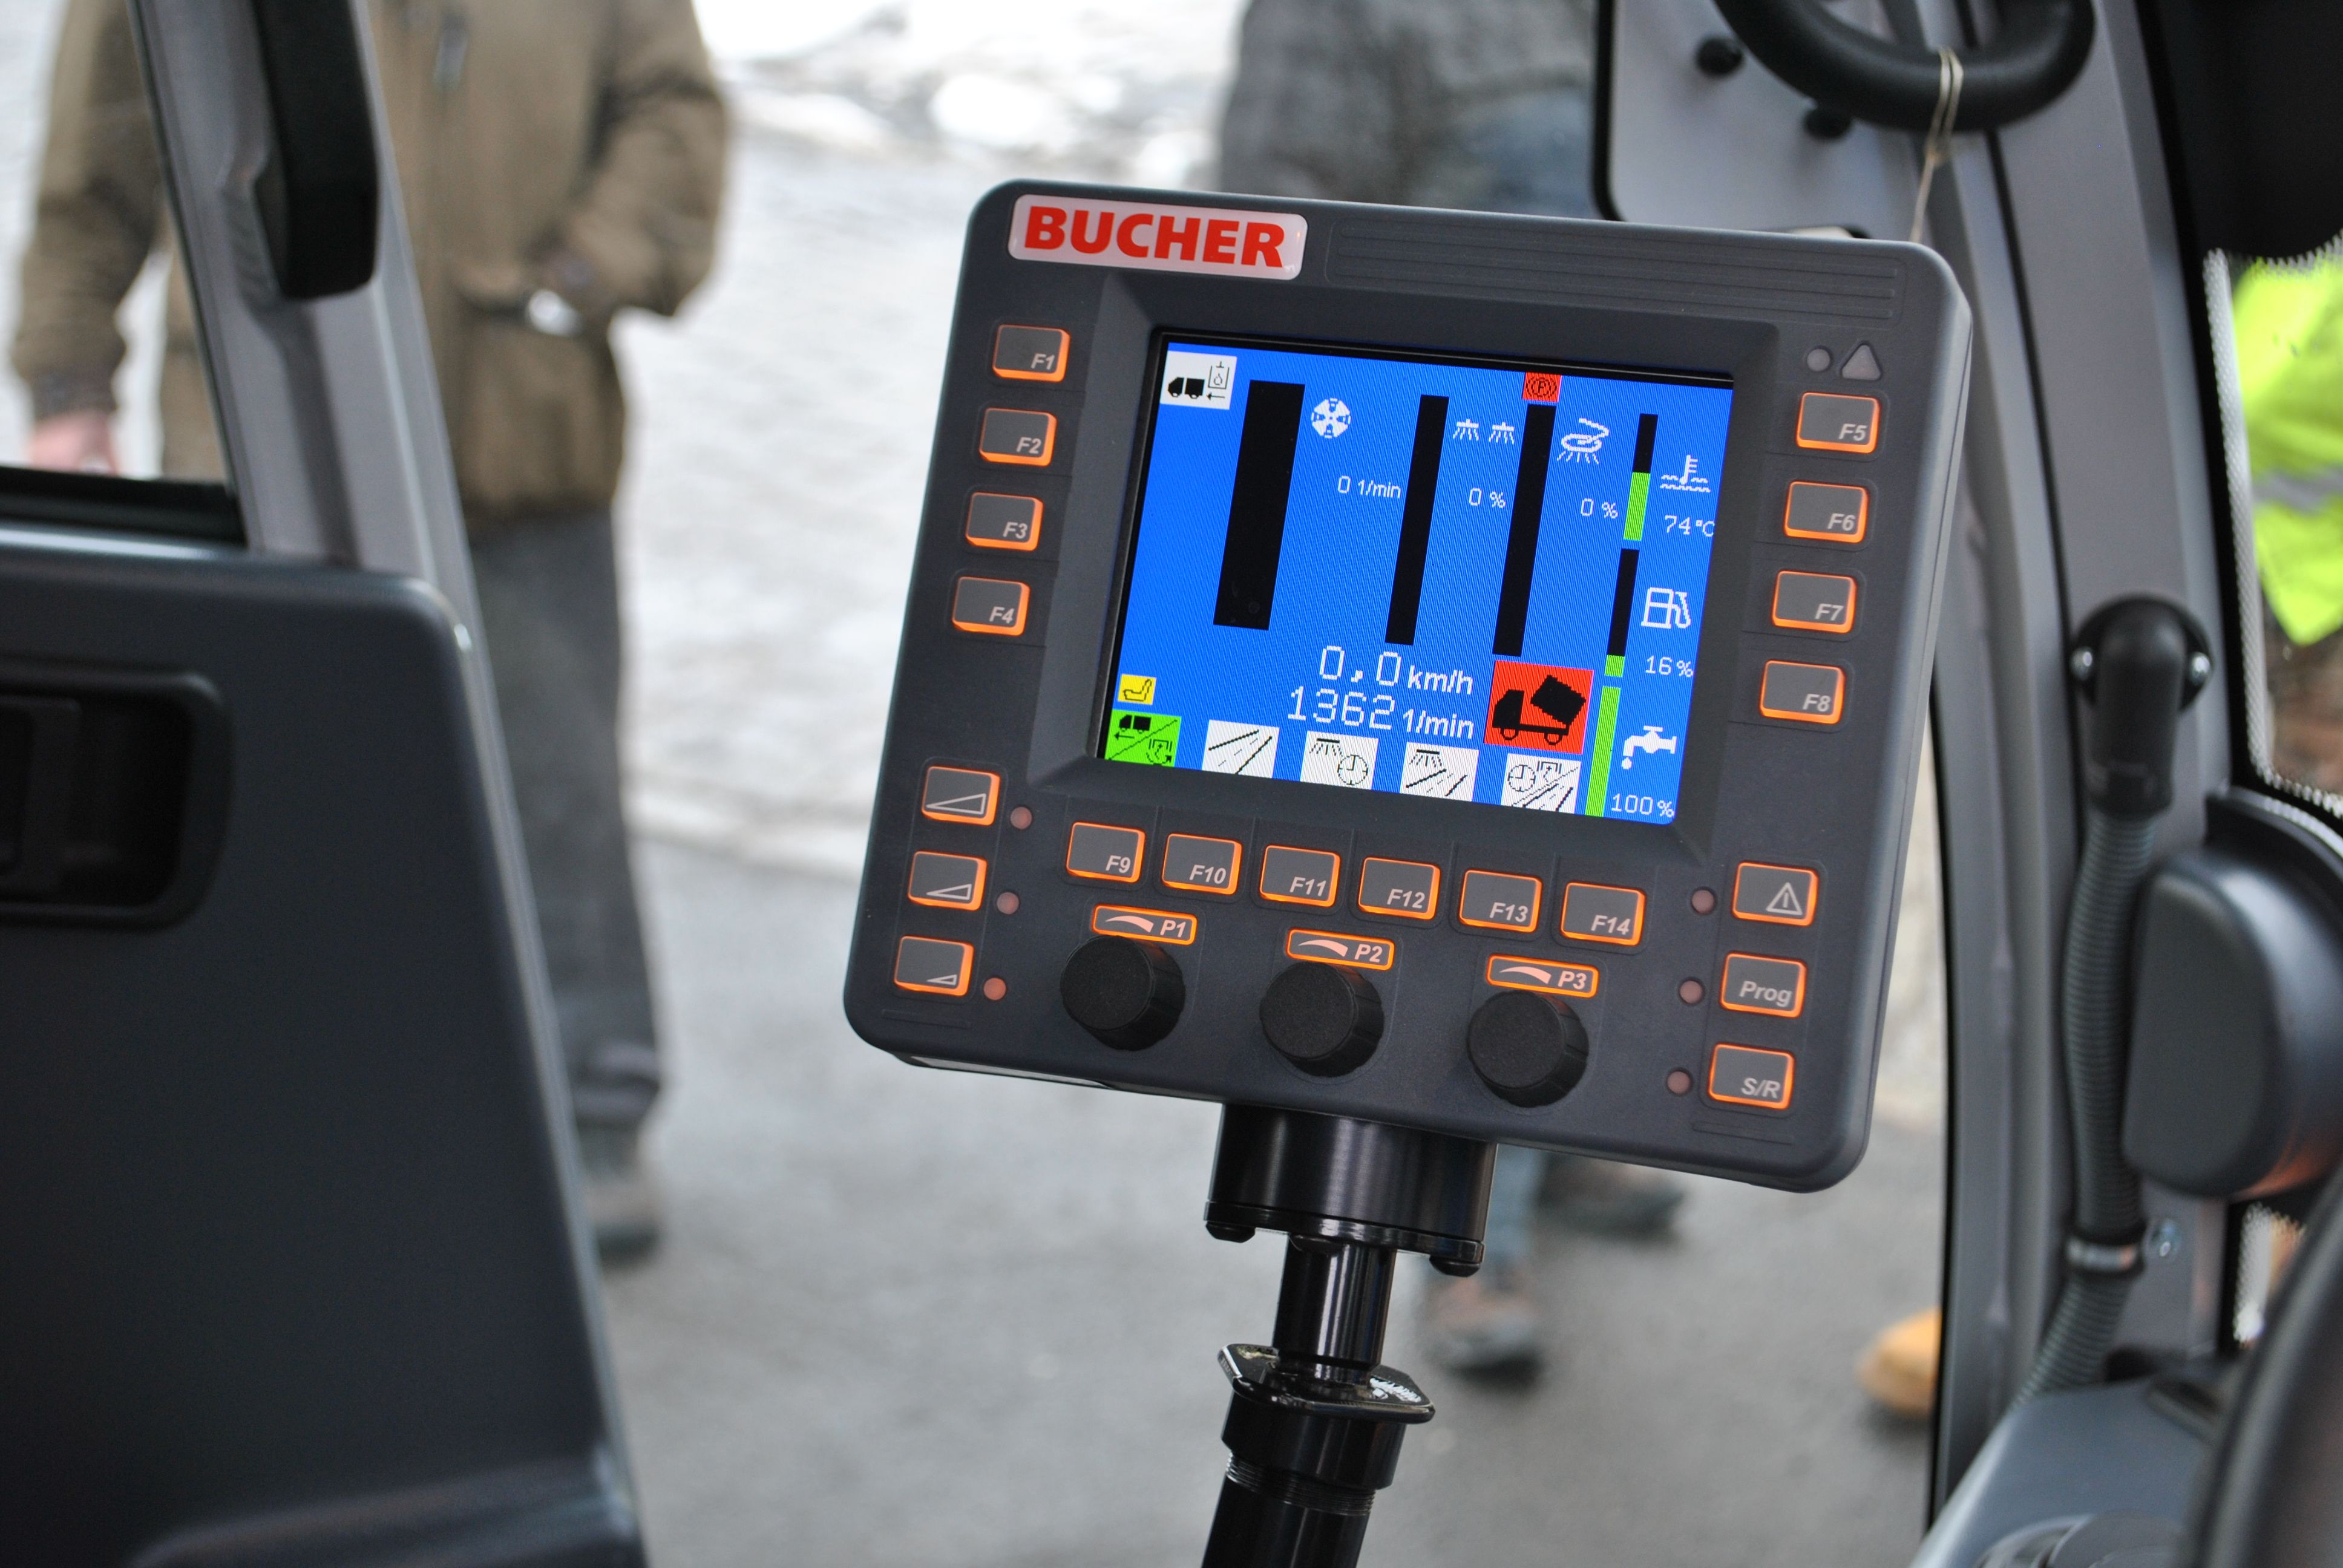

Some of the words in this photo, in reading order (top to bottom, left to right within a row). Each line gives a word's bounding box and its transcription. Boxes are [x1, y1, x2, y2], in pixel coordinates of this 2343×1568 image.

[1024, 206, 1285, 268] BUCHER
[1031, 353, 1055, 370] F1
[1838, 423, 1867, 442] F5
[1016, 437, 1042, 454] F2
[1337, 475, 1351, 494] 0
[1358, 479, 1401, 498] 1/min
[1469, 488, 1482, 506] 0
[1489, 491, 1506, 508] %
[1580, 498, 1594, 517] 0
[1601, 501, 1619, 518] %
[1003, 521, 1028, 539] F3
[1827, 513, 1856, 531] F6
[989, 606, 1015, 624] F4
[1815, 603, 1844, 621] F7
[1319, 645, 1401, 686] 0,0
[1407, 665, 1473, 694] km/h
[1288, 685, 1395, 730] 1362
[1403, 709, 1474, 739] 1/min
[1802, 693, 1831, 712] F8
[1106, 855, 1131, 874] F9
[1189, 864, 1227, 884] F10
[1289, 877, 1326, 897] F11
[1387, 888, 1425, 909] F12
[1489, 902, 1529, 923] F13
[1159, 920, 1187, 938] P1
[1591, 914, 1631, 935] F14
[1354, 943, 1383, 963] P2
[1557, 970, 1587, 990] P3
[1739, 980, 1793, 1008] Prog
[1741, 1077, 1781, 1099] S/R
